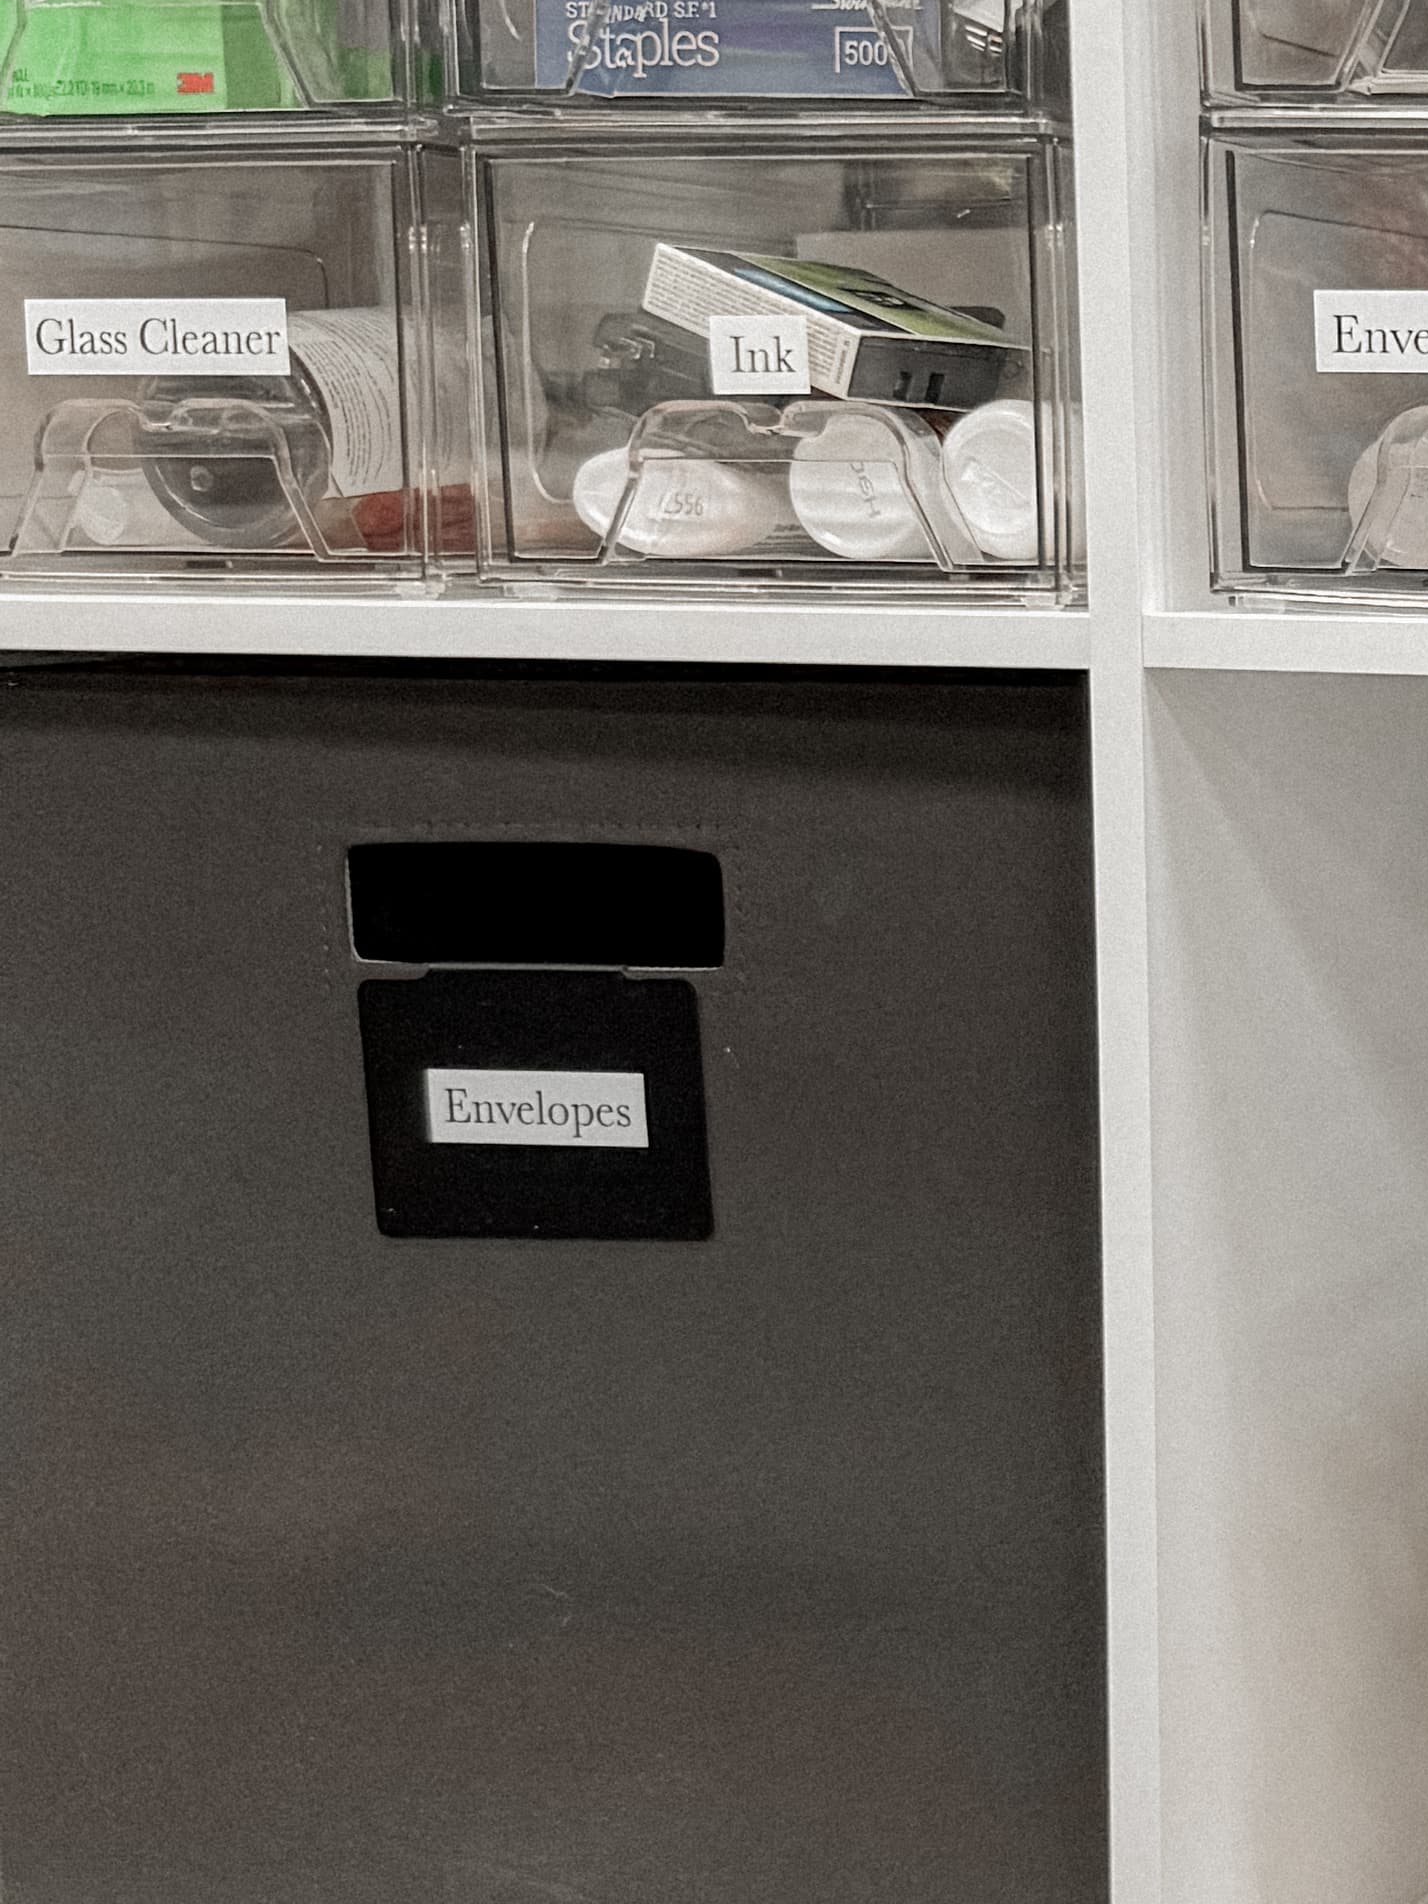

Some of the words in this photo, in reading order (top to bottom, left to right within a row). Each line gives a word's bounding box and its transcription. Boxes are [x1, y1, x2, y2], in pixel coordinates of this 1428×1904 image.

[566, 1, 667, 23] STNDARD
[567, 17, 720, 78] Staples
[35, 317, 128, 357] Glass
[139, 317, 282, 357] Cleaner
[729, 334, 797, 374] Ink
[444, 1087, 632, 1138] Envelopes
